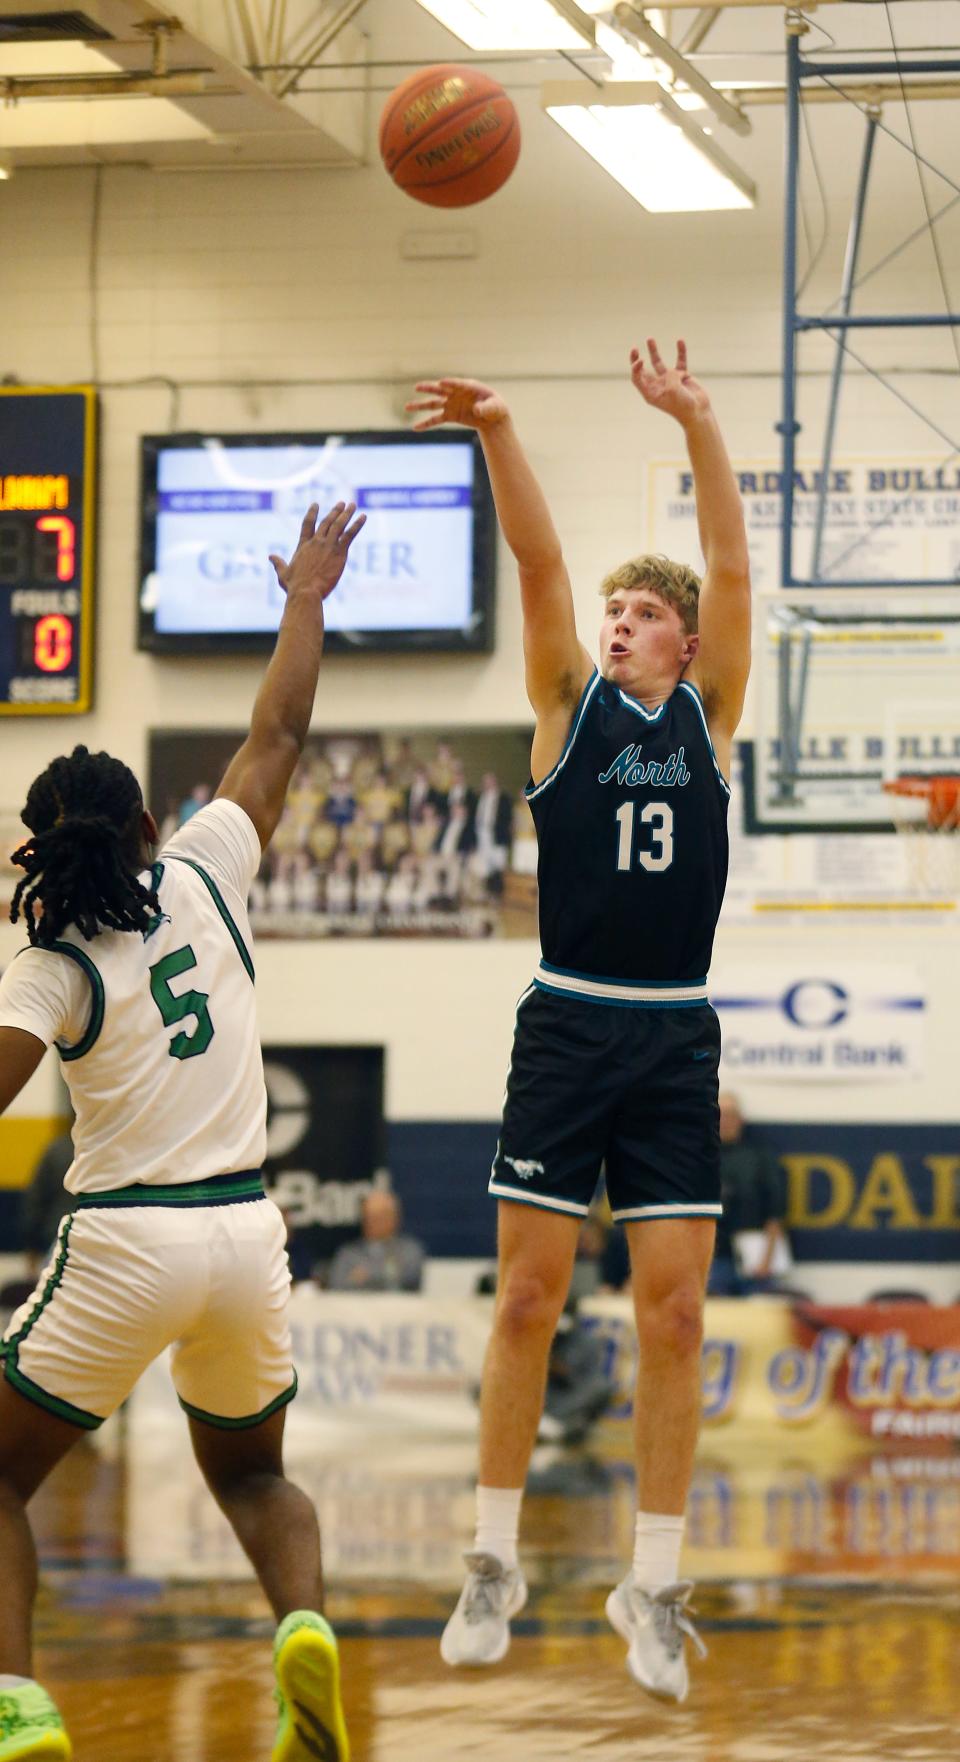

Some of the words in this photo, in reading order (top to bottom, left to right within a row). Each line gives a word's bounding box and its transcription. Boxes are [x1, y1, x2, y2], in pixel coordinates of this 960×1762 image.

[36, 515, 76, 582] 7
[34, 613, 73, 671] 0
[598, 743, 691, 787] North
[616, 801, 674, 872] 13
[149, 943, 215, 1061] 5
[722, 1041, 823, 1066] Central
[833, 1040, 907, 1065] Bank
[768, 1327, 848, 1419] of
[848, 1328, 960, 1399] the
